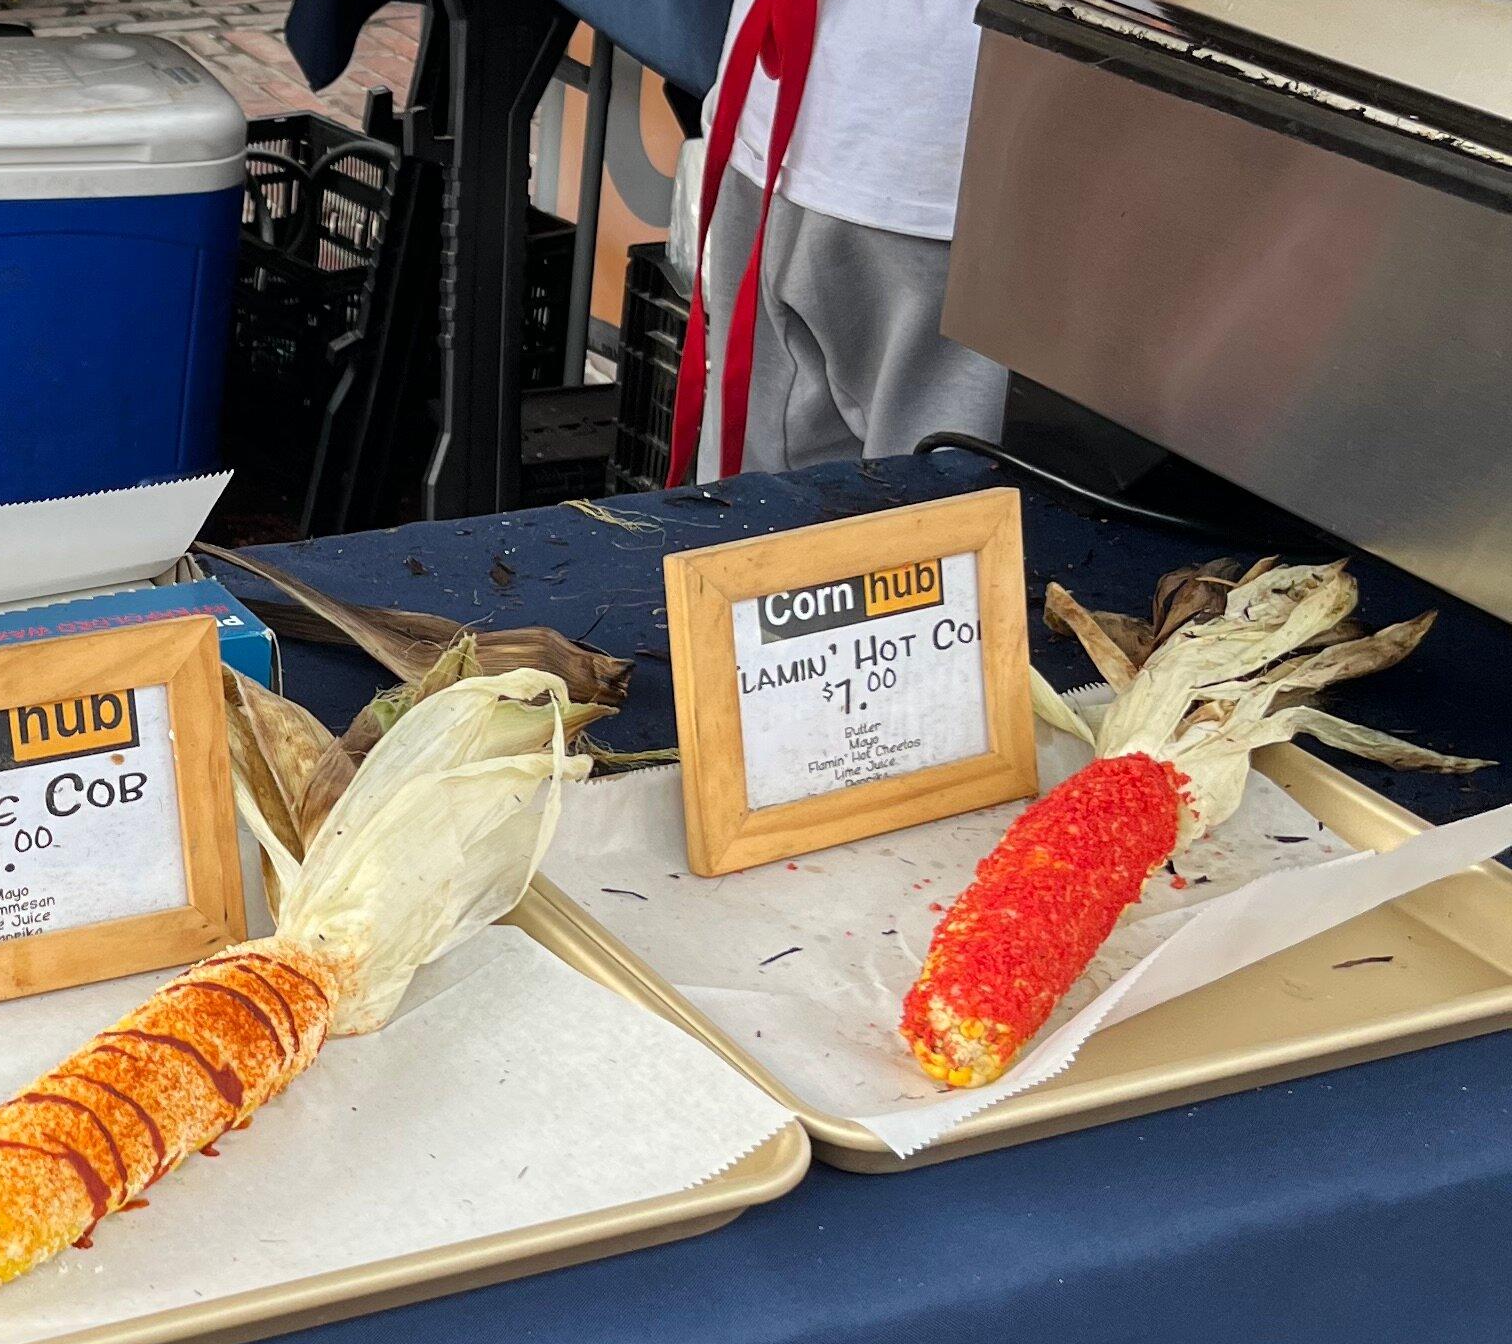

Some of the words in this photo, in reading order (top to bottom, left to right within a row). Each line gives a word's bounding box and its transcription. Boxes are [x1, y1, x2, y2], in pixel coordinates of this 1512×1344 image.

[764, 582, 855, 627] Corn
[869, 563, 935, 604] hub
[737, 643, 838, 694] LAMIN'
[932, 618, 982, 651] CO
[18, 692, 123, 744] hub
[45, 772, 148, 817] COB
[11, 911, 51, 927] Juice
